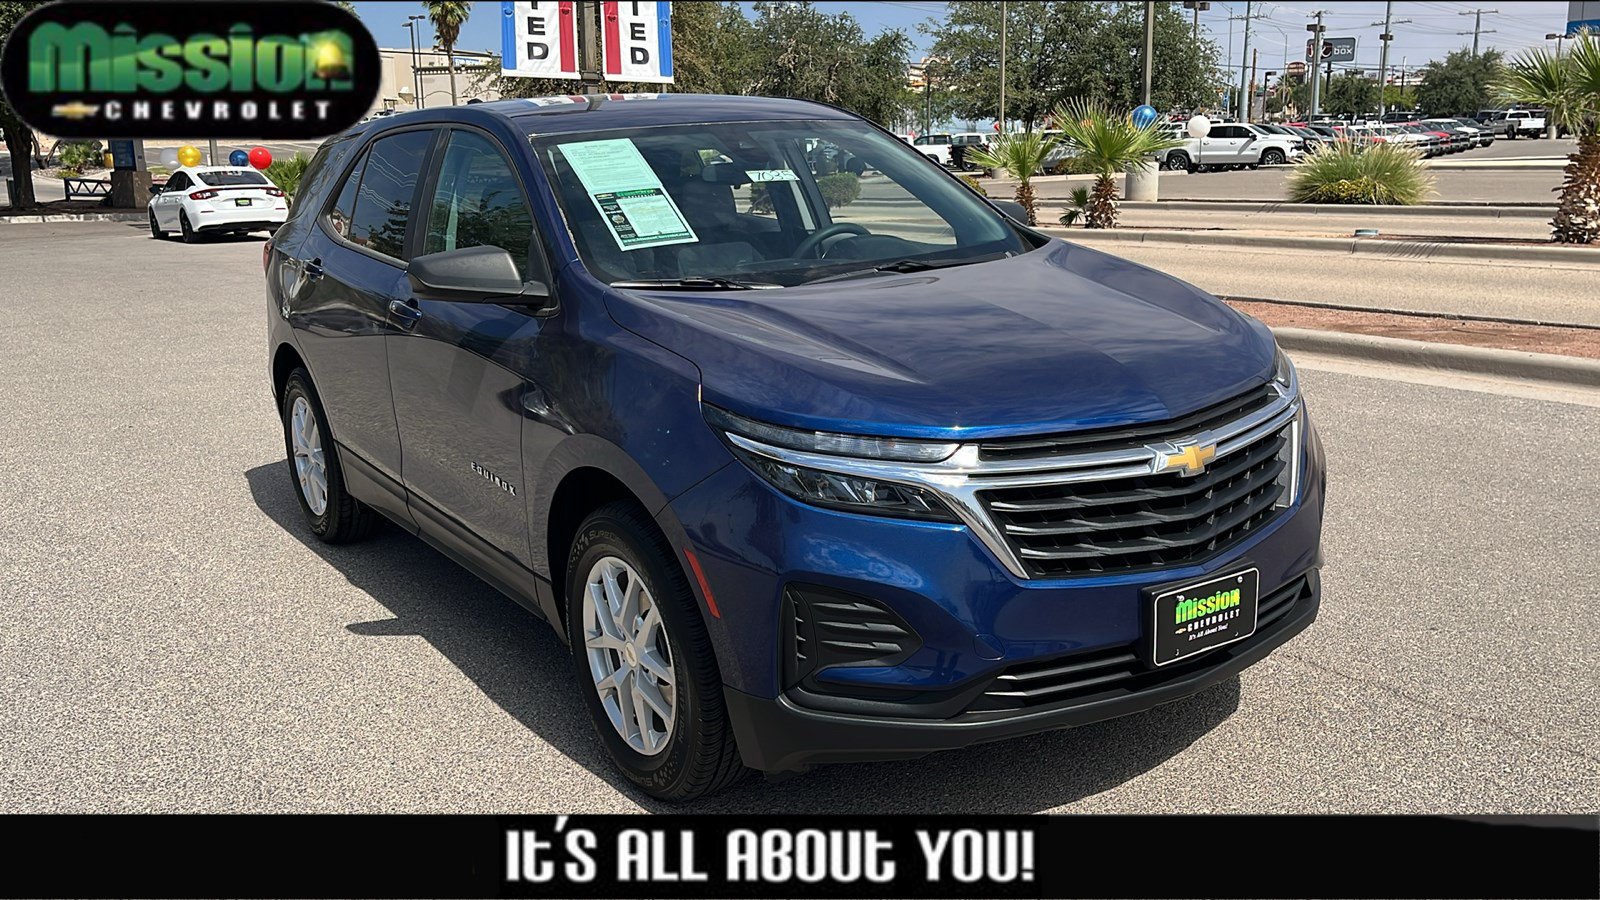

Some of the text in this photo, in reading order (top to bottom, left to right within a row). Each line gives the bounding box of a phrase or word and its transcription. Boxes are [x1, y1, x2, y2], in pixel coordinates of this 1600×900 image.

[1333, 47, 1353, 55] box
[748, 170, 797, 181] 7035
[471, 461, 516, 496] EQUINOX
[1187, 608, 1240, 632] CHEVROLET
